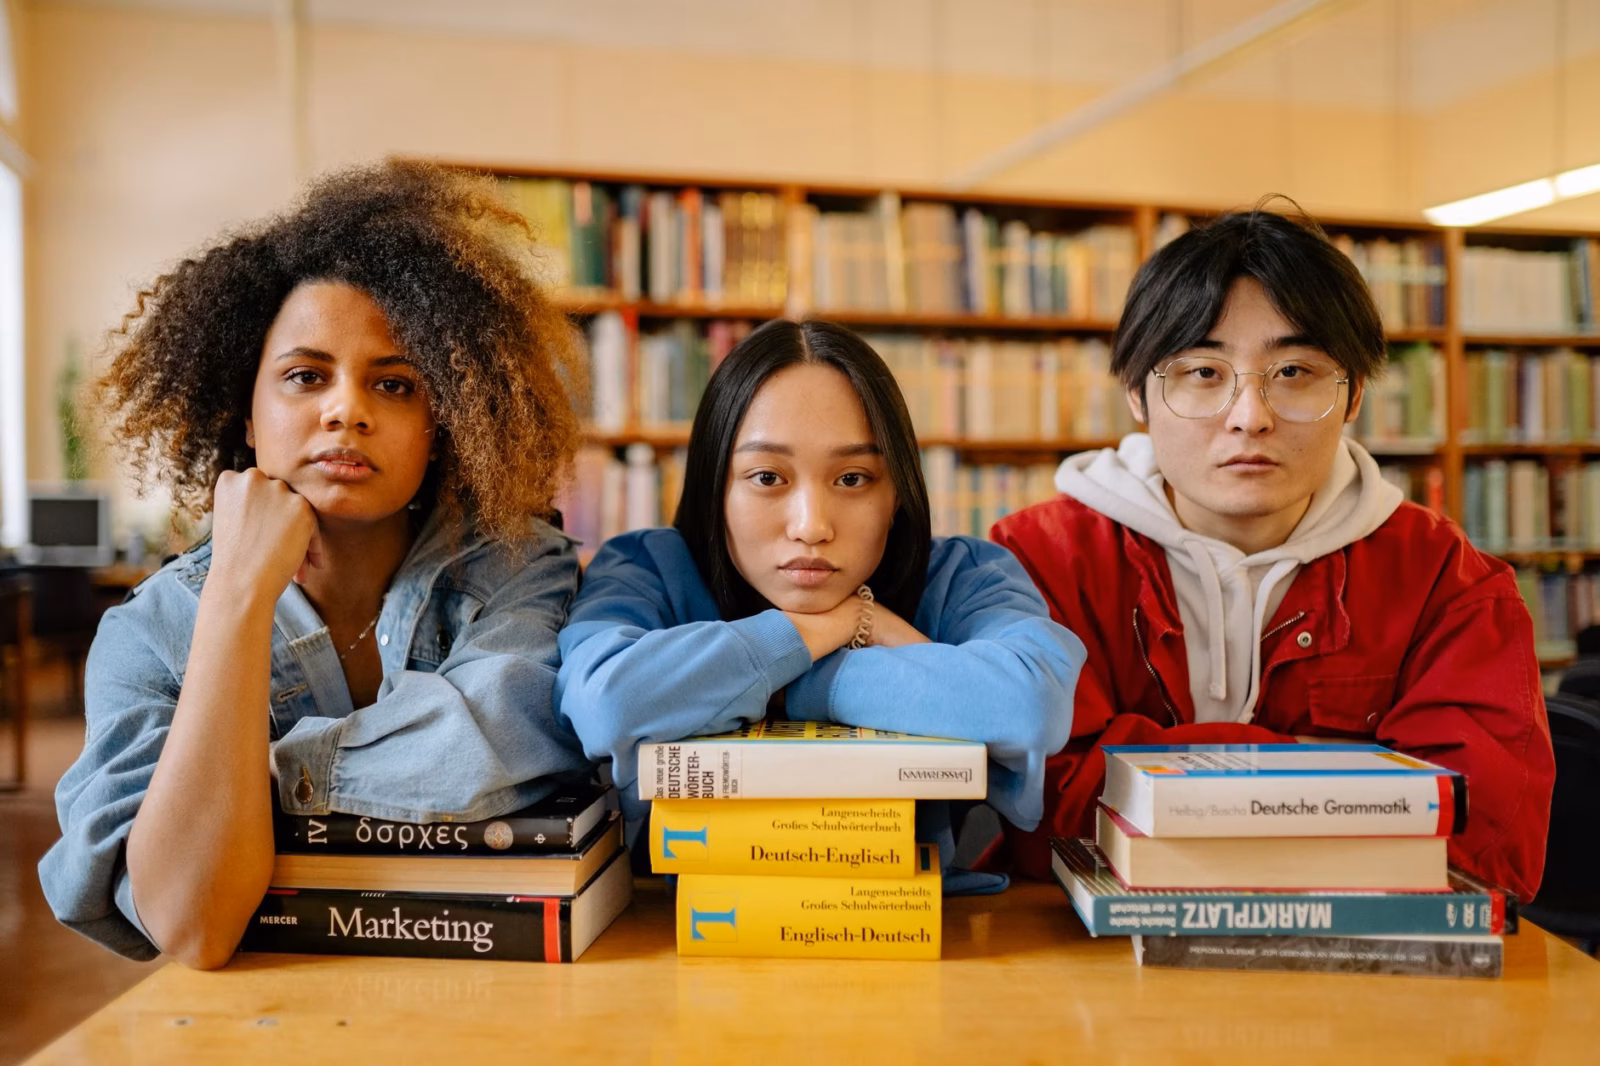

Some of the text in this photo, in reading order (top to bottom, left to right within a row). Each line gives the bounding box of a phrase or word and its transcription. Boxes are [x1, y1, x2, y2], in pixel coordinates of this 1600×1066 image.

[656, 767, 664, 785] neue
[668, 745, 681, 799] DEUTSCHE
[684, 751, 699, 799] WÖRTER-
[702, 771, 714, 799] BUCH
[821, 807, 902, 820] Langenscheidts
[1250, 798, 1319, 816] Deutsche
[1324, 797, 1412, 816] Grammatik
[811, 820, 902, 833] Schulwörterbuch
[750, 845, 901, 868] Deutsch-Englisch
[850, 887, 932, 899] Langenscheidts
[840, 900, 932, 913] Schulwörterbuch
[1181, 902, 1333, 929] MARKTPLATZ
[259, 915, 298, 926] MERCER
[327, 906, 494, 953] Marketing
[780, 926, 931, 947] Englisch-Deutsch
